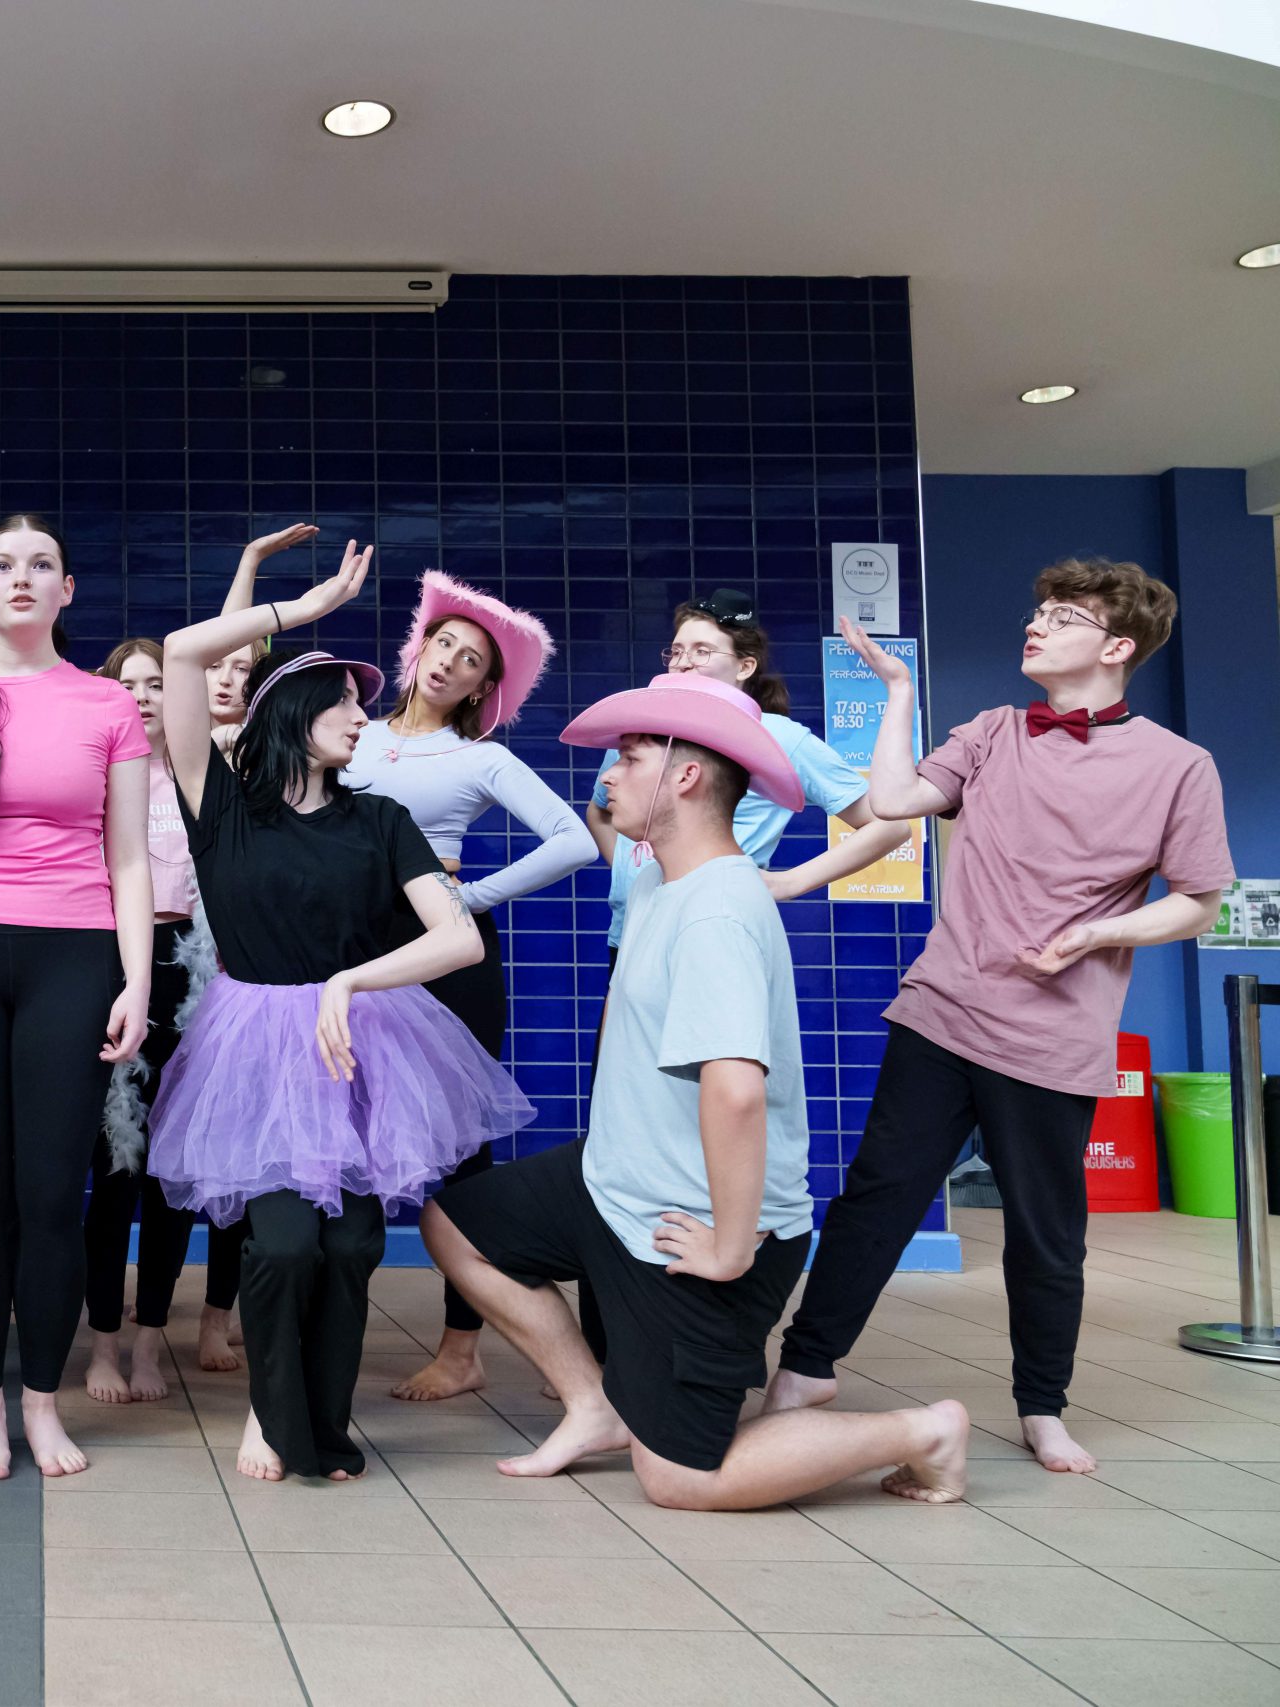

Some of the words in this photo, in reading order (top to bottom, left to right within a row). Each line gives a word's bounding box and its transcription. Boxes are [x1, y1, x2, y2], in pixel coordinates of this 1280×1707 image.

[832, 715, 864, 728] 18:30
[844, 752, 864, 760] JWC
[870, 884, 904, 894] ATRIUM
[1086, 1142, 1115, 1156] IRE
